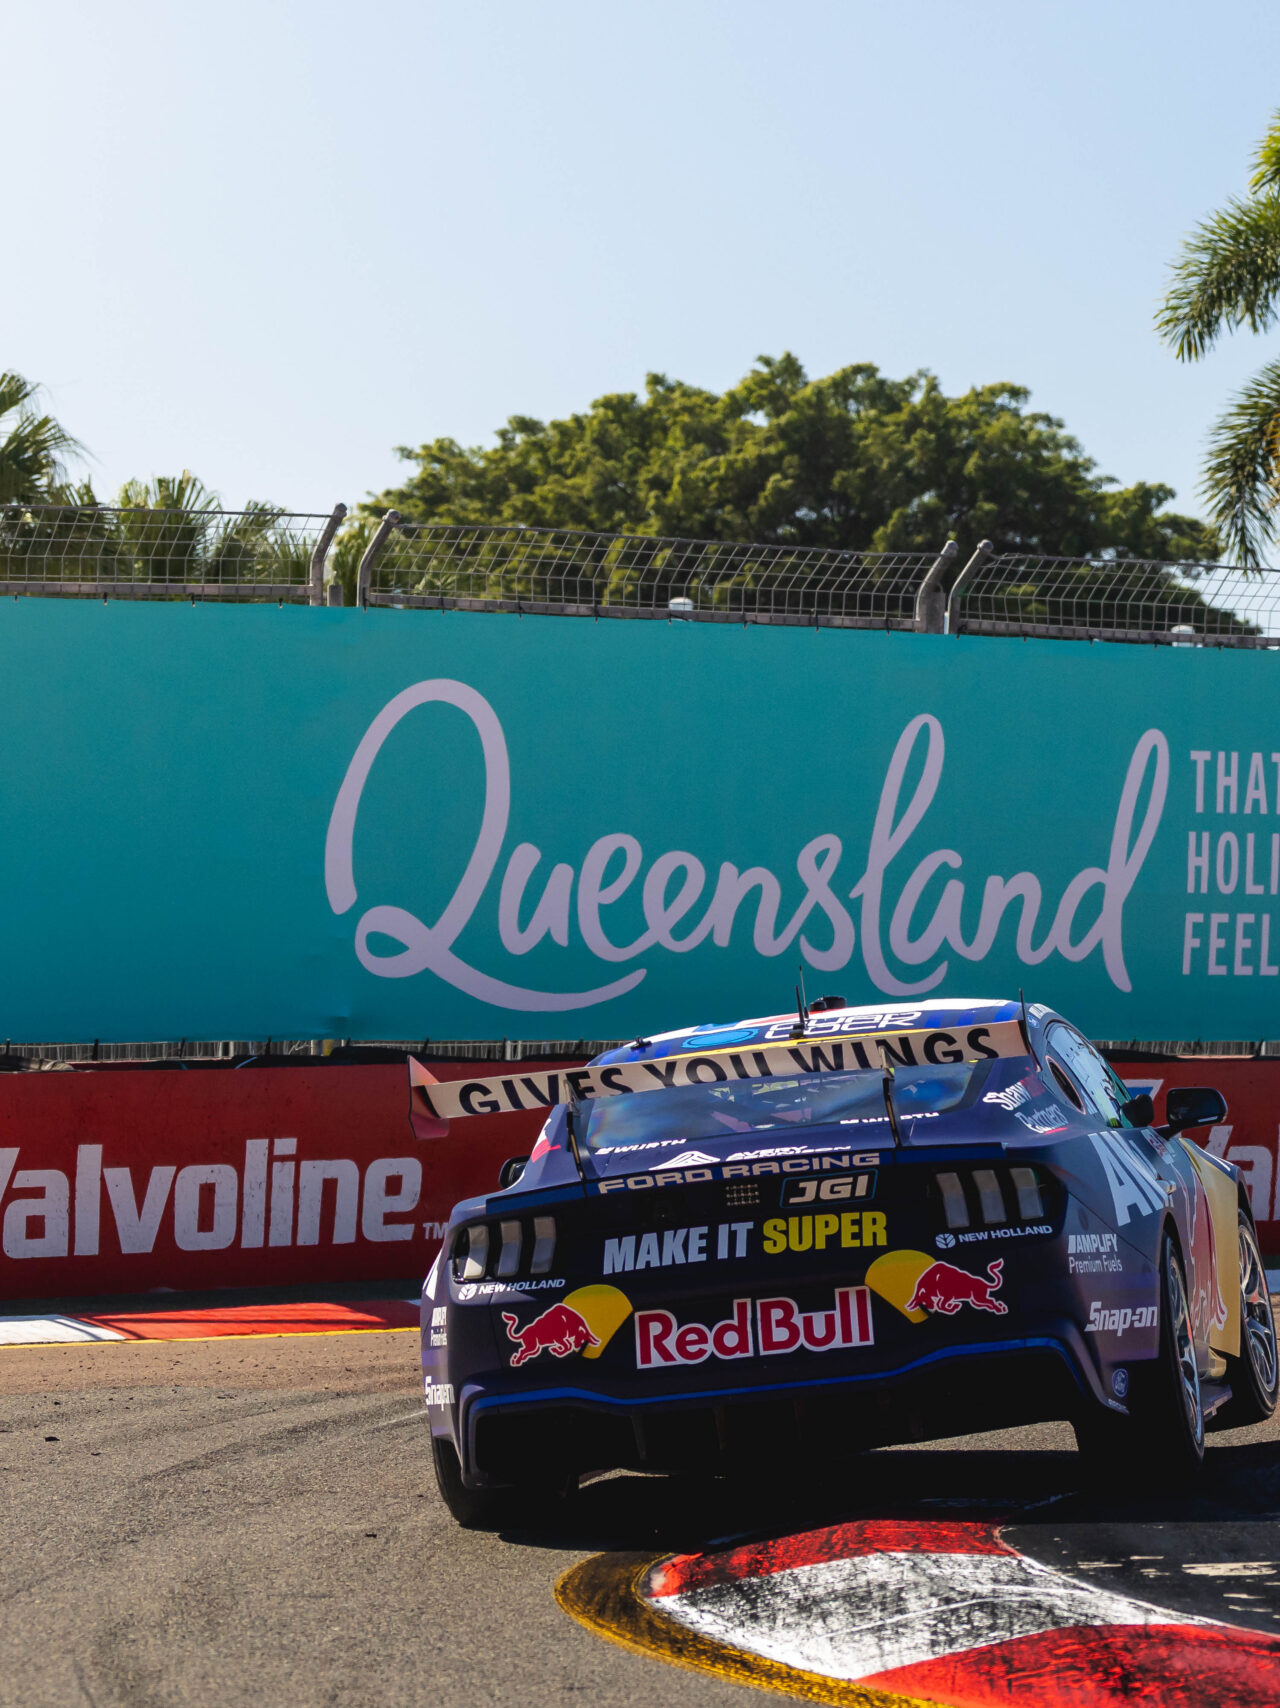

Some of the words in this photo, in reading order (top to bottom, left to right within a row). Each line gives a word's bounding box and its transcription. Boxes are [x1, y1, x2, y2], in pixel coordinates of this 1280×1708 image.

[324, 678, 1170, 1011] Queensland
[458, 1066, 634, 1114] GIVES
[642, 1051, 772, 1089] YOU
[788, 1027, 999, 1071] WINGS
[598, 1169, 712, 1194] FORD
[722, 1152, 880, 1179] RACING
[789, 1174, 869, 1204] JGI
[603, 1223, 707, 1275] MAKE
[717, 1221, 754, 1259] IT
[763, 1211, 887, 1254] SUPER
[958, 1232, 987, 1244] NEW
[989, 1225, 1053, 1240] HOLLAND
[1076, 1234, 1118, 1253] AMPLIFY
[1069, 1256, 1102, 1274] Premium
[1103, 1254, 1123, 1272] Fuels
[478, 1284, 506, 1295] NEW
[506, 1279, 566, 1292] HOLLAND
[635, 1298, 754, 1369] Red
[757, 1285, 875, 1356] Bull
[1084, 1301, 1158, 1336] Snap-on
